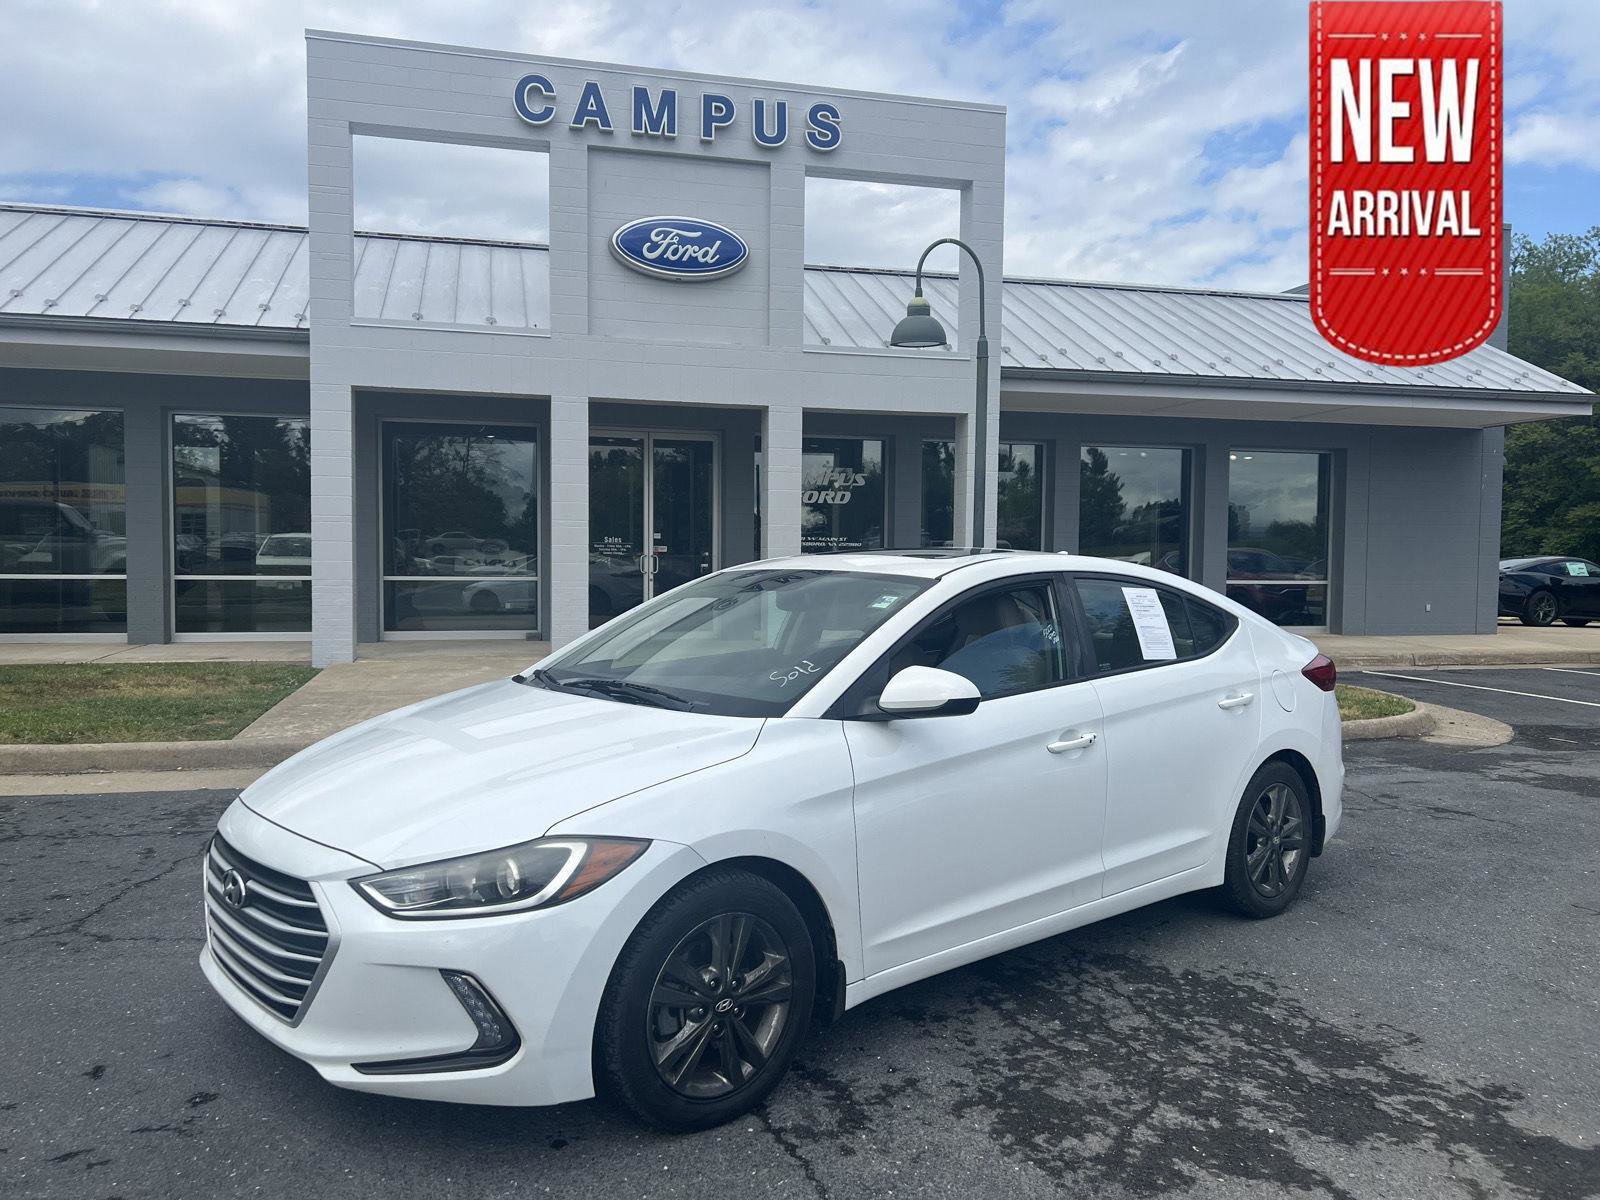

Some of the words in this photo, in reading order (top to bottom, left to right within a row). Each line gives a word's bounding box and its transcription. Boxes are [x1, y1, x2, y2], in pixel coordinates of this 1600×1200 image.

[513, 73, 843, 151] CAMPUS
[642, 227, 721, 265] Ford
[803, 470, 868, 487] MPUS
[801, 490, 852, 504] ORD
